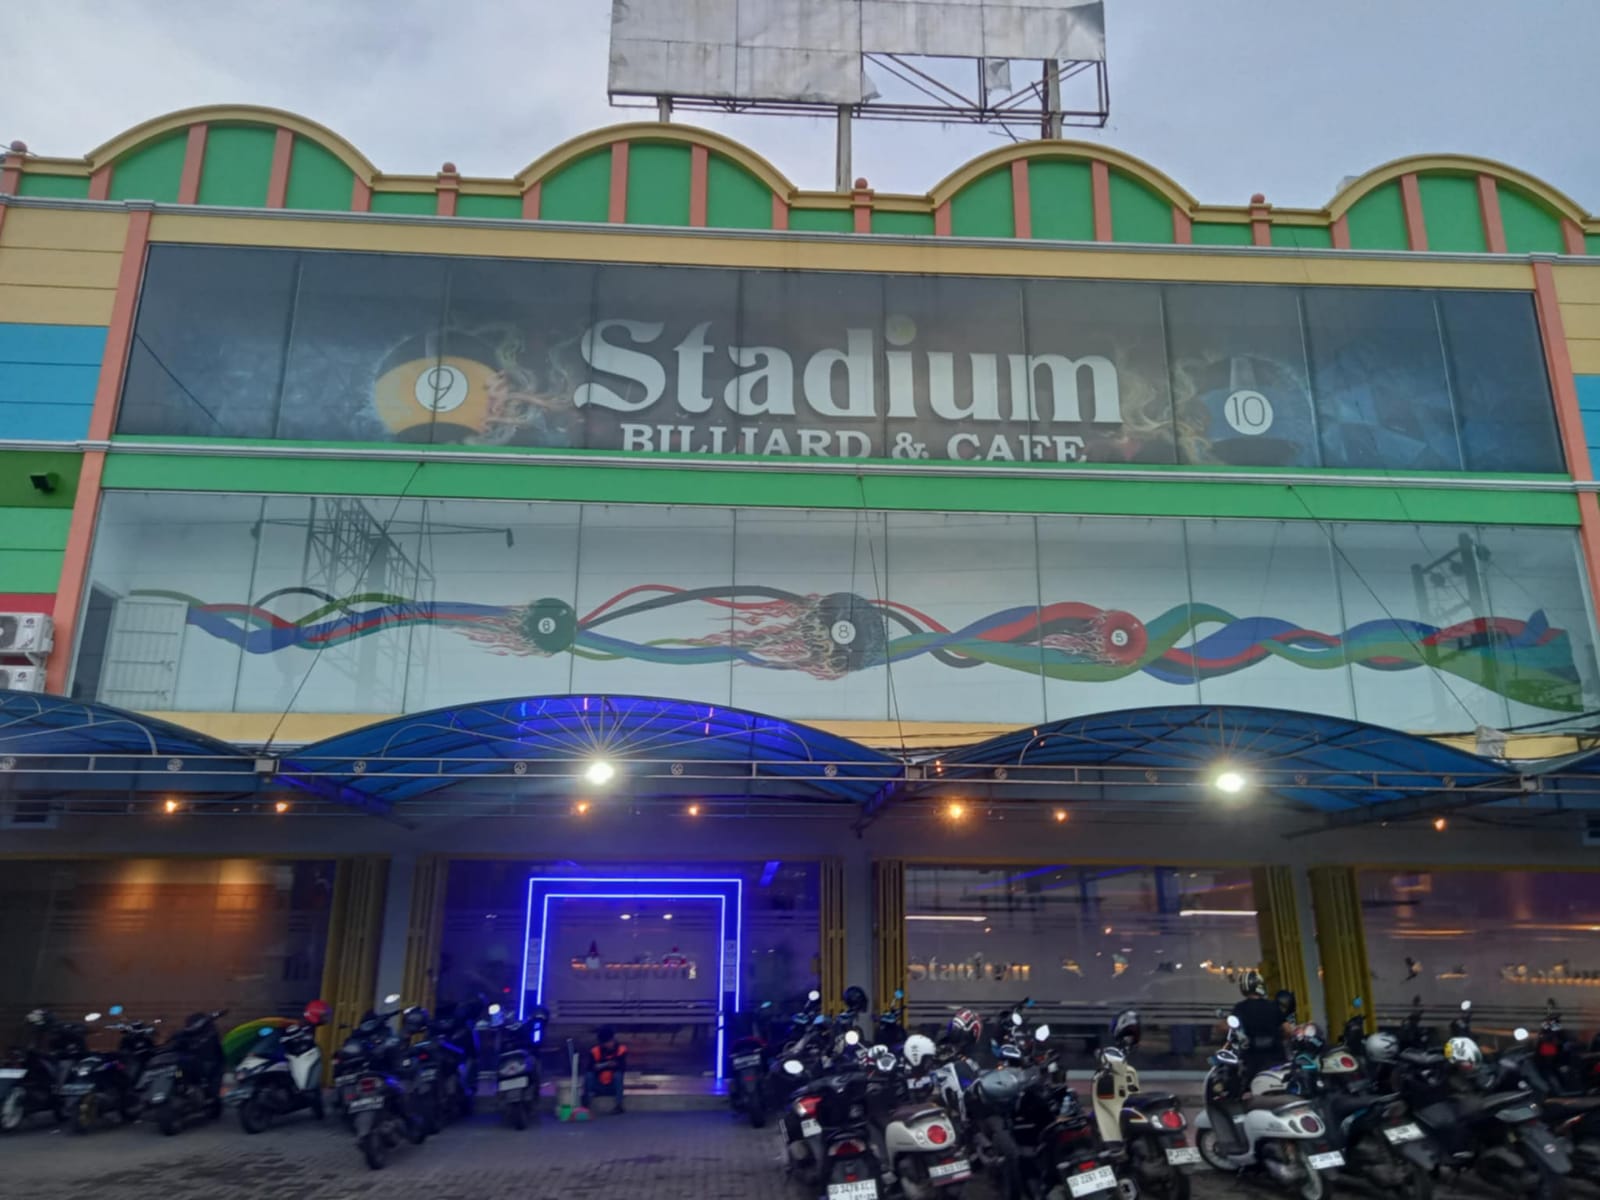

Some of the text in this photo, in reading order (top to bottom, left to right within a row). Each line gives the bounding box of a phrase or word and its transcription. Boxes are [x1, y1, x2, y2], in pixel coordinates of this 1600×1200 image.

[427, 367, 455, 409] 9
[573, 314, 1123, 424] Stadium
[1232, 396, 1266, 427] 10
[620, 423, 1087, 463] BILLIARD & CAFE
[837, 624, 850, 639] 8
